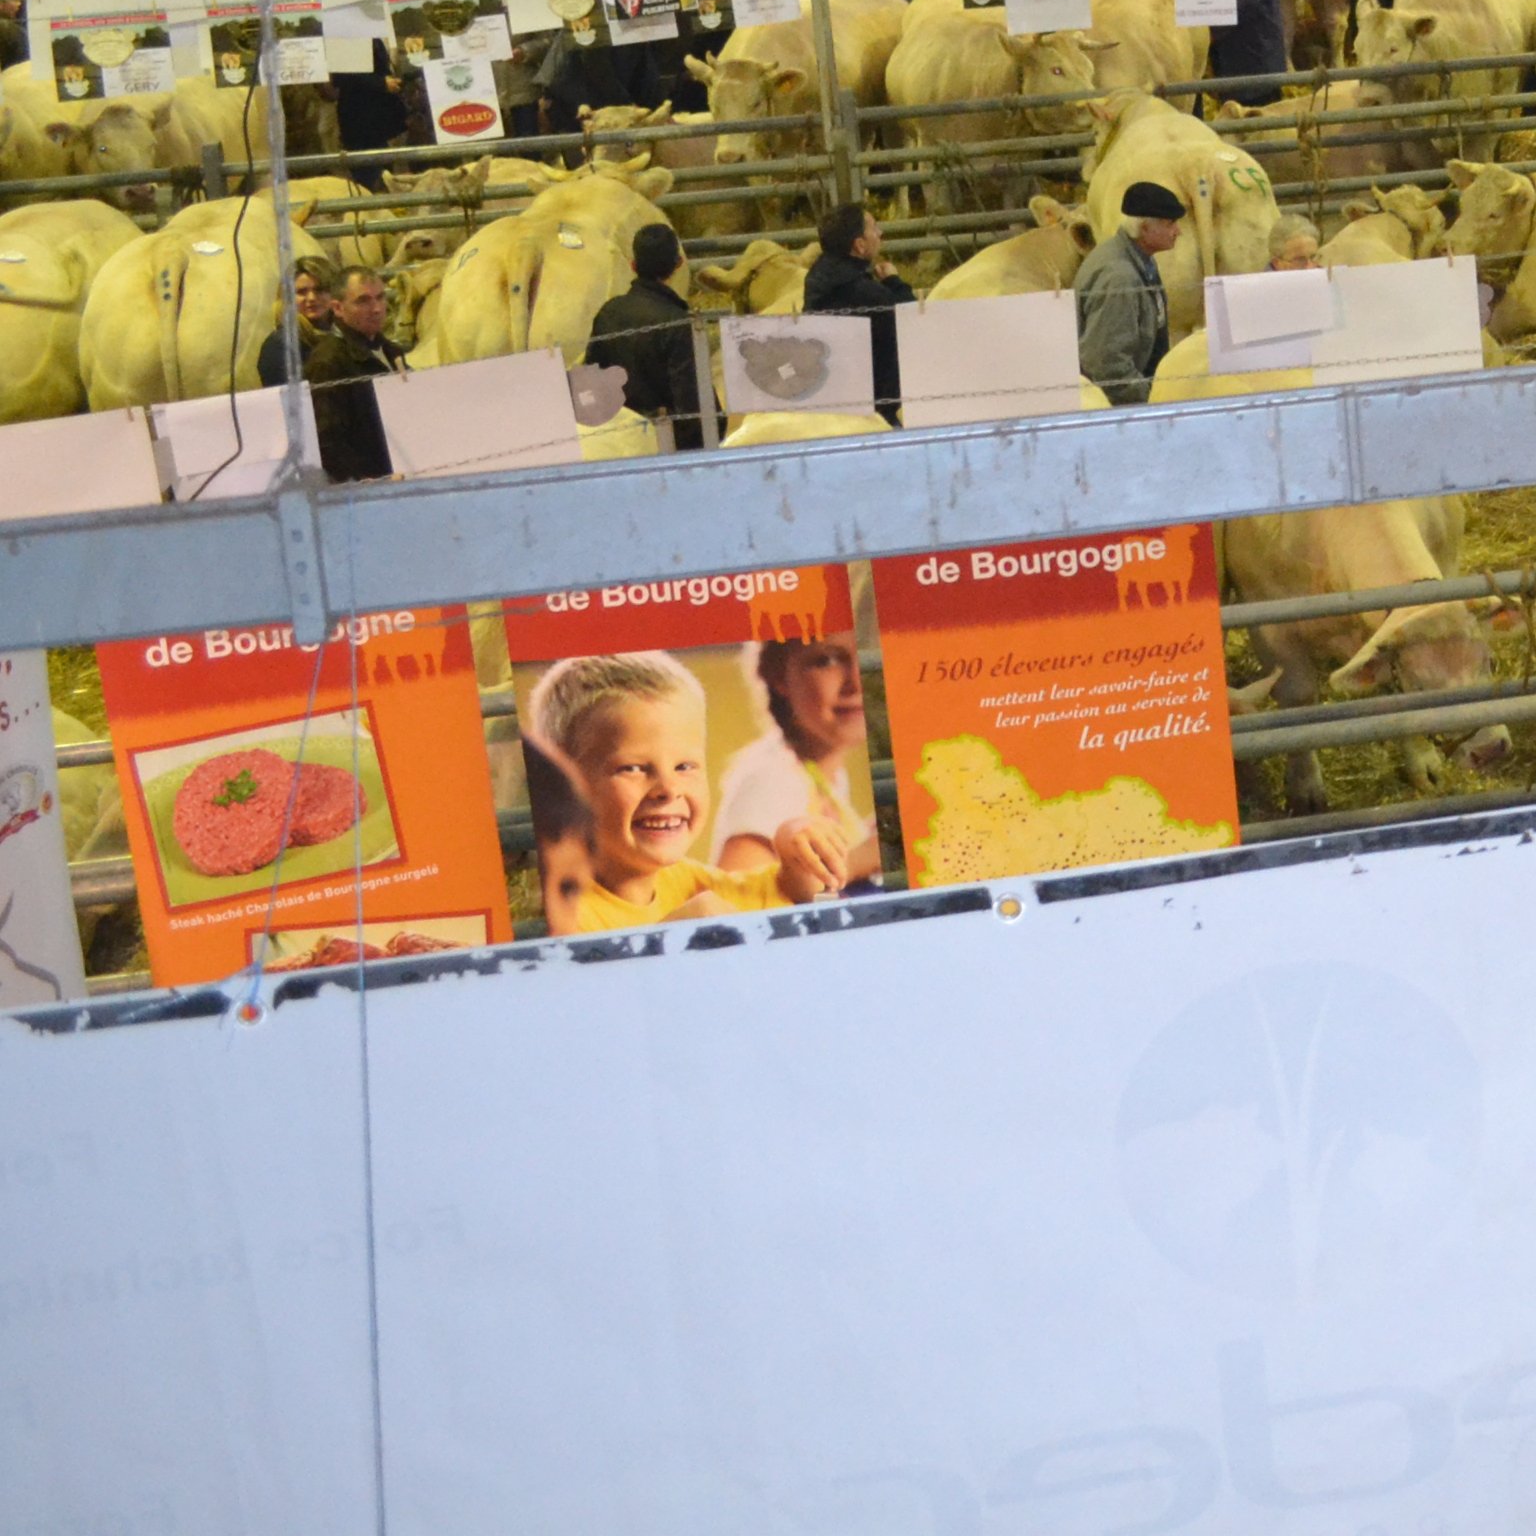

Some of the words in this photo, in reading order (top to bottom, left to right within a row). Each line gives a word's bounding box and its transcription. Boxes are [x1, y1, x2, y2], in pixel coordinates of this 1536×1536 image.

[916, 557, 960, 585] de
[971, 538, 1166, 581] Bourgogne
[602, 570, 799, 610] Bourgogne
[146, 638, 193, 667] de
[204, 610, 415, 660] Bourogne
[917, 657, 983, 683] 1500
[990, 653, 1095, 678] éleveurs
[1103, 633, 1205, 667] engagés
[980, 688, 1045, 708] mettent
[1050, 683, 1084, 701] leur
[1088, 669, 1189, 699] savoir-faire
[1193, 668, 1210, 681] et
[995, 711, 1030, 728] leur
[1033, 705, 1101, 729] passion
[1105, 702, 1127, 714] au
[1131, 693, 1187, 712] service
[1191, 687, 1211, 702] de
[1079, 725, 1105, 750] la
[1113, 711, 1212, 752] qualité.
[169, 915, 205, 931] Steak
[207, 907, 243, 925] haché
[307, 890, 322, 902] de
[392, 863, 440, 884] surgelé
